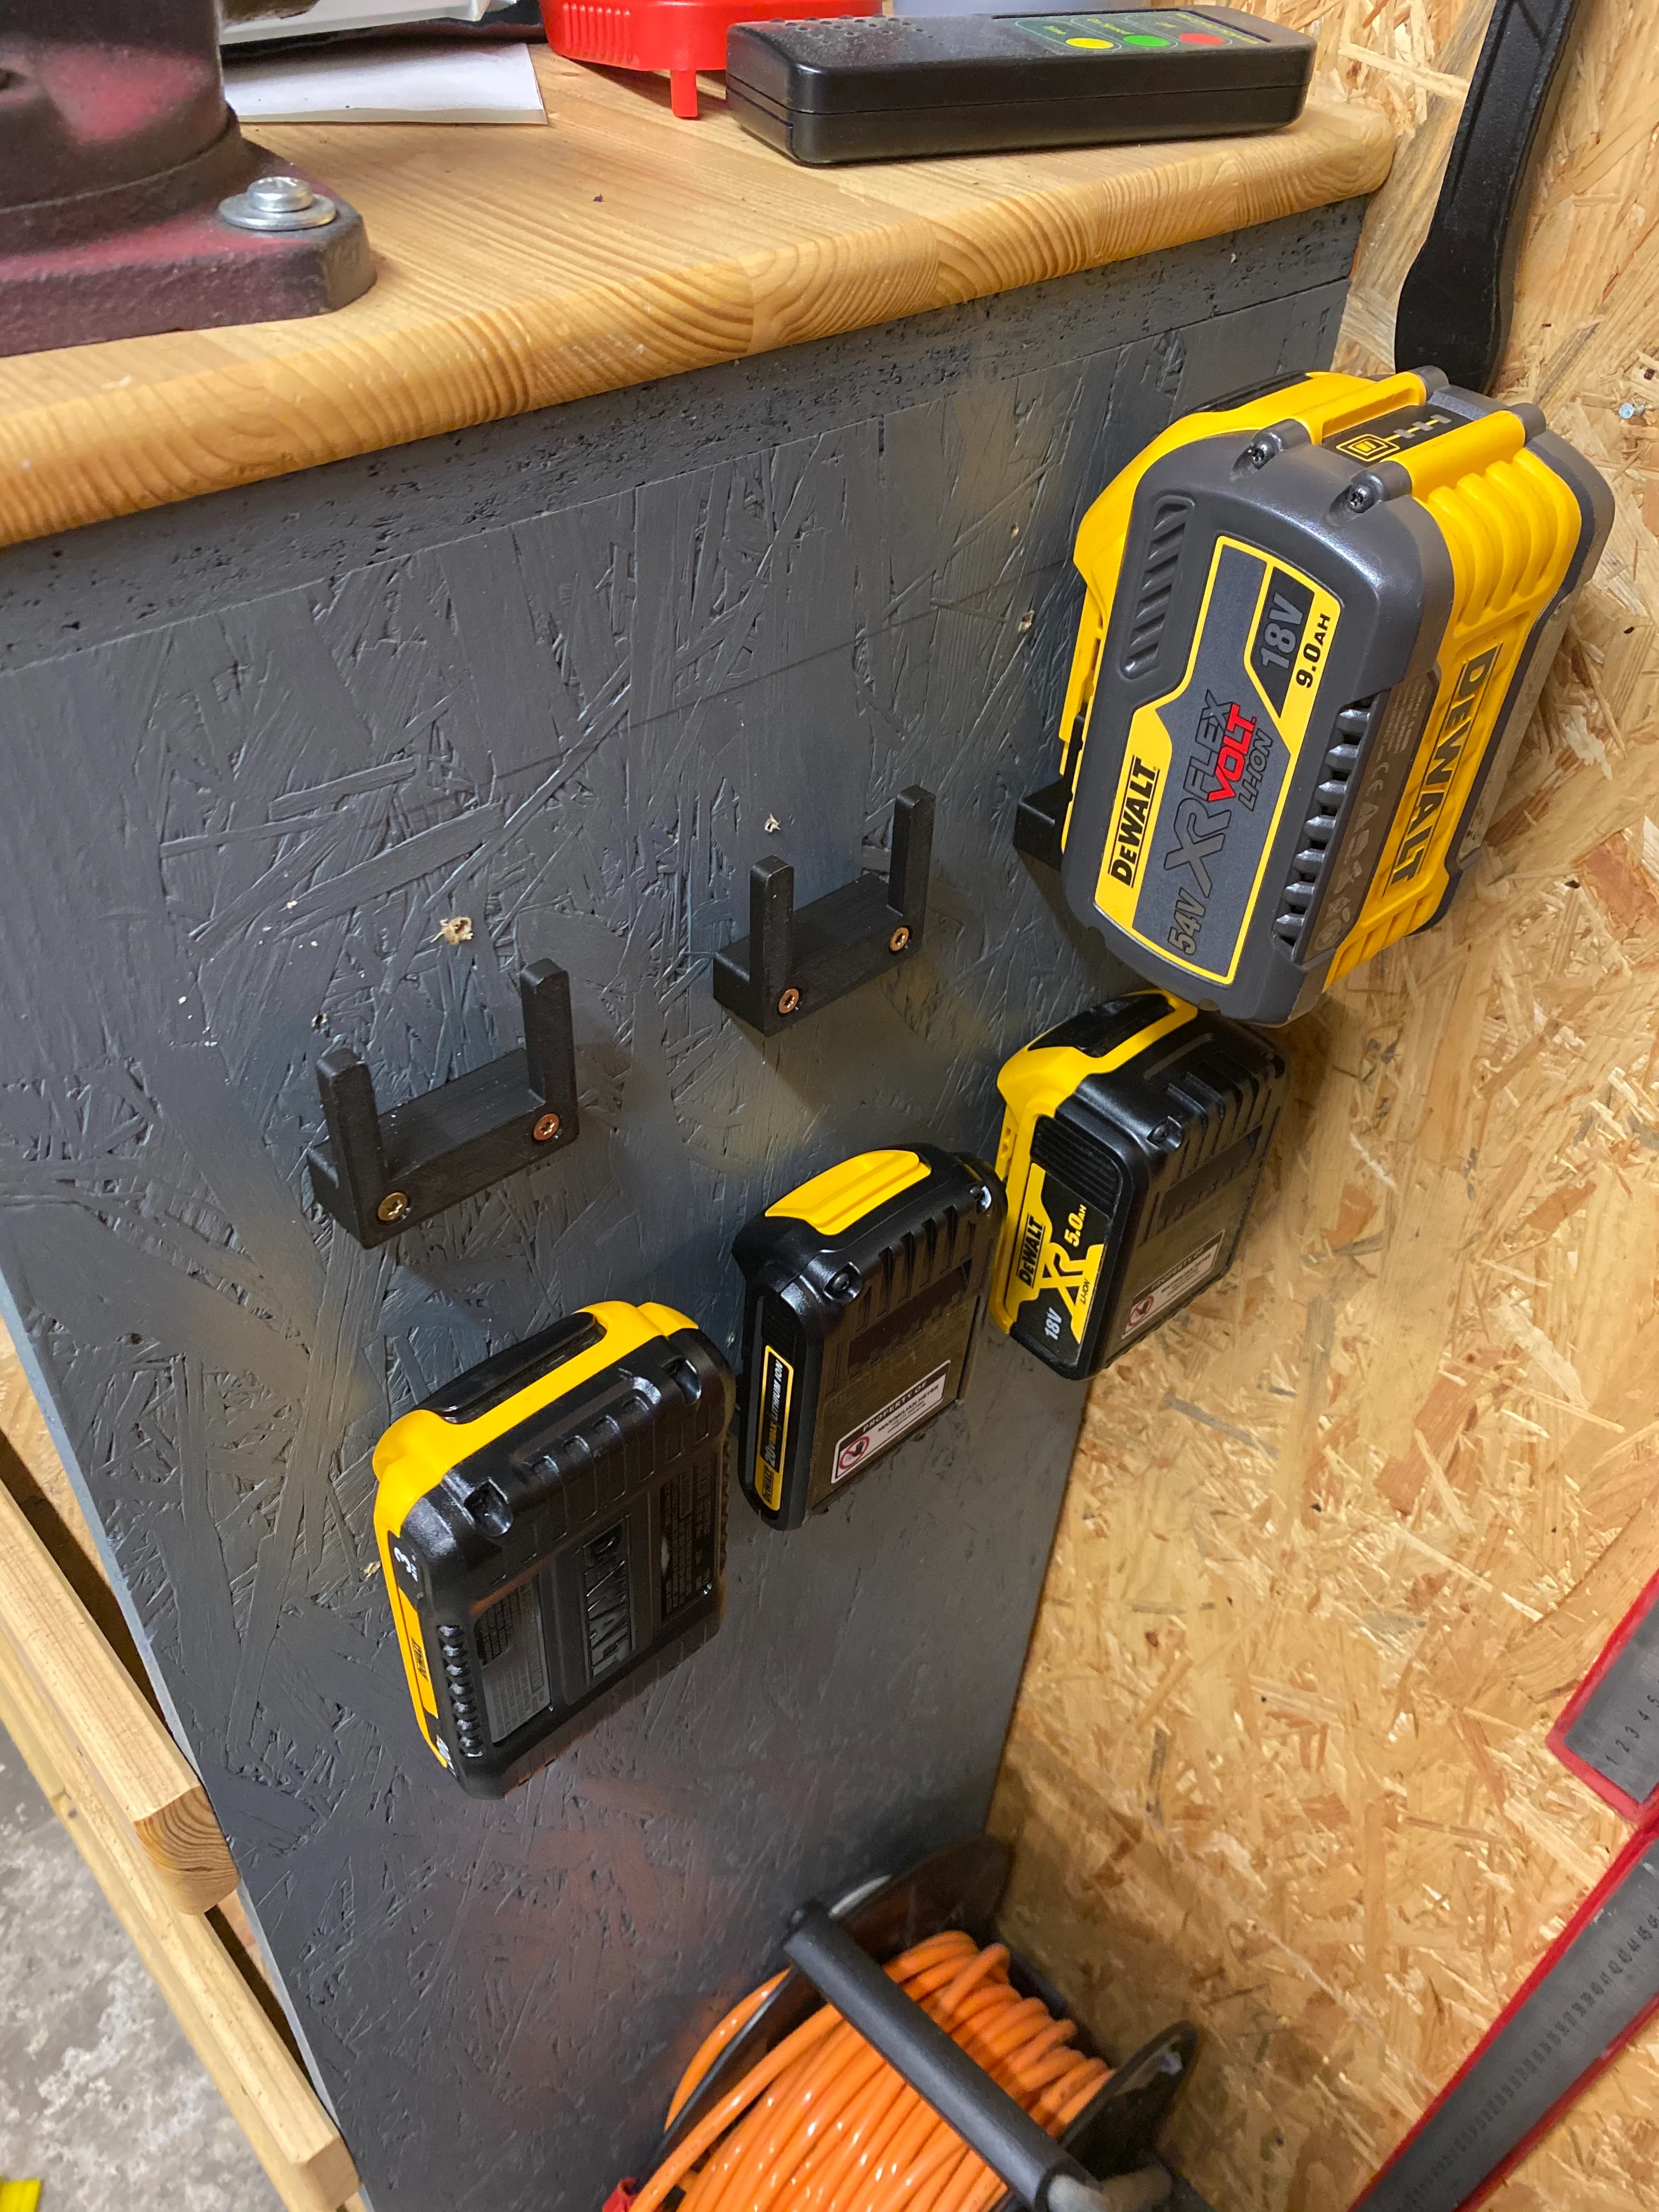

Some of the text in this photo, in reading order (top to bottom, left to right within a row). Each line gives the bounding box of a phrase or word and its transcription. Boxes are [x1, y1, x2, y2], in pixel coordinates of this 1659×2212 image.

[1260, 590, 1303, 669] 18V
[1207, 702, 1254, 802] VOLT
[1238, 727, 1273, 812] LI-ION
[1390, 646, 1498, 885] DEWALT
[1110, 758, 1156, 886] DEWALT
[1164, 689, 1237, 956] 54V XR FLEX
[1018, 1215, 1045, 1288] DEWALT
[1044, 1307, 1062, 1340] 18V
[771, 1379, 781, 1421] LITHIUM
[775, 1359, 783, 1383] ION
[863, 1393, 912, 1432] PROPERTY
[914, 1381, 927, 1393] OF
